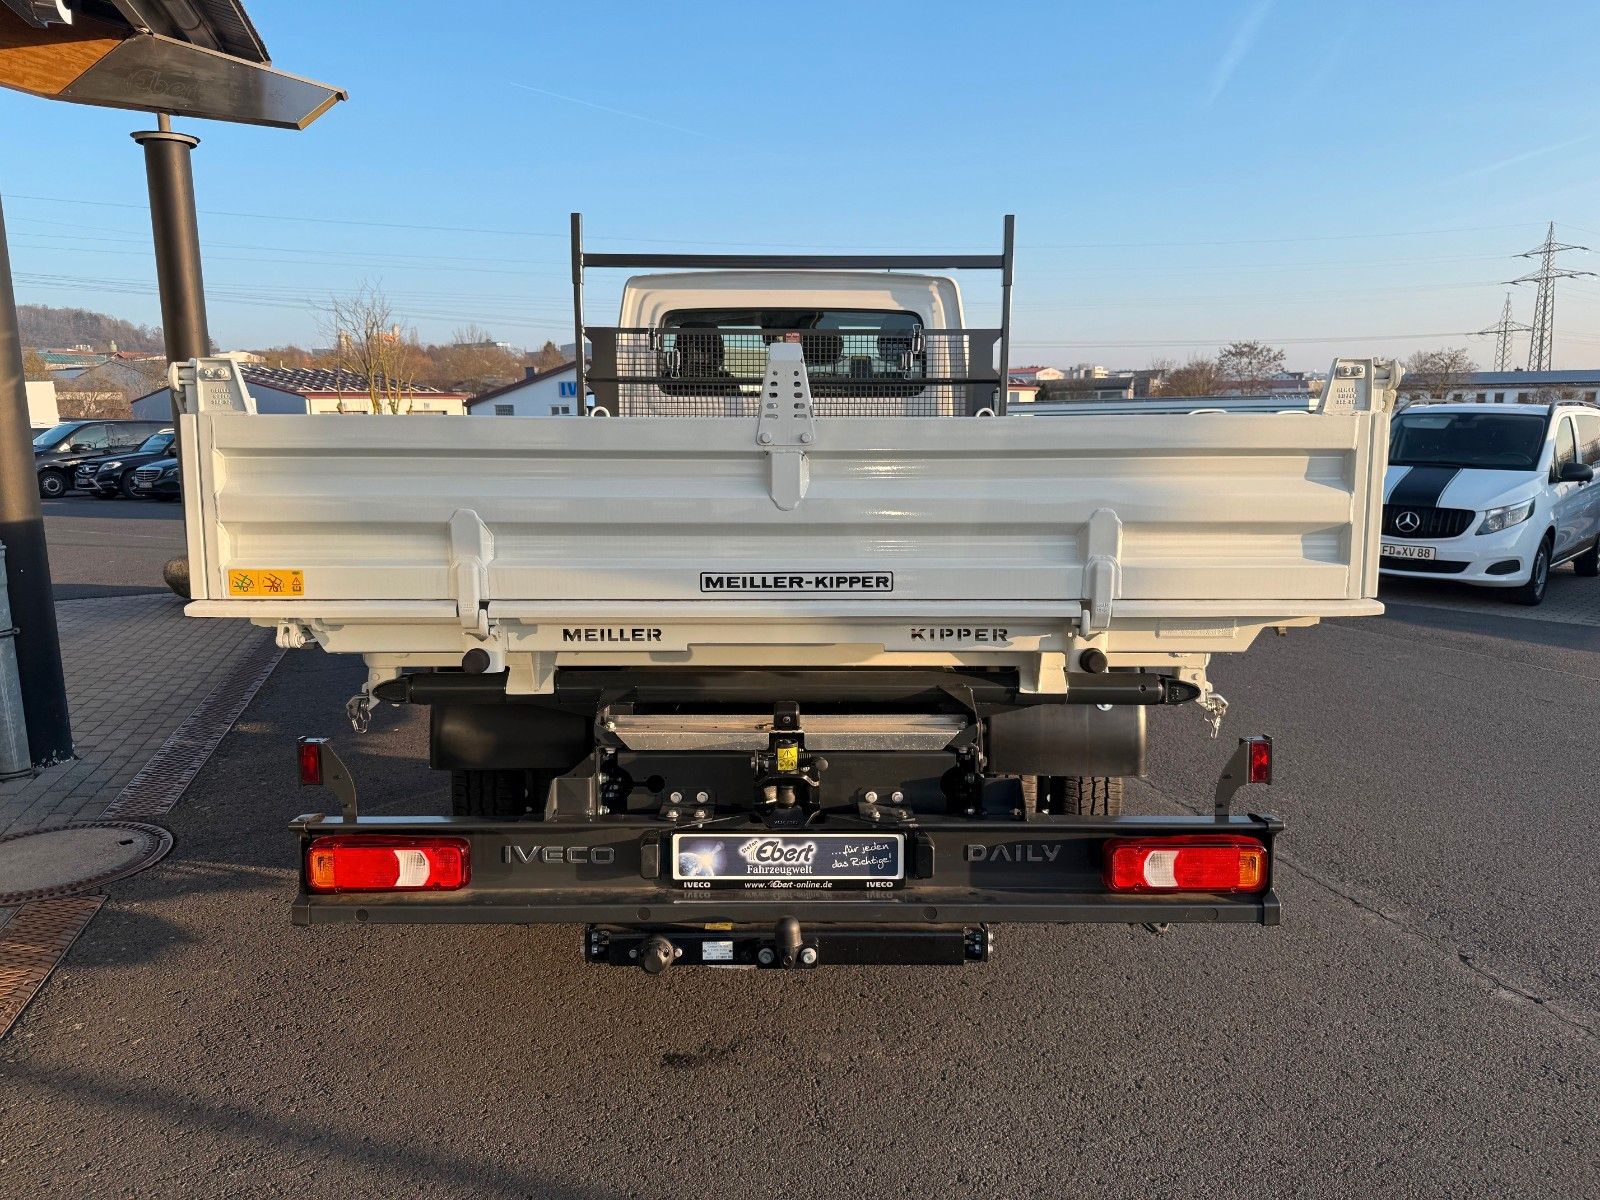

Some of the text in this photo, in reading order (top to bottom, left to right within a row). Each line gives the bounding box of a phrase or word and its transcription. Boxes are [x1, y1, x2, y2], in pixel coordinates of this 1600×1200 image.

[1382, 545, 1430, 558] FD XV 88
[705, 576, 890, 589] MEILLER-KIPPER
[562, 628, 662, 642] MEILLER
[911, 628, 1008, 642] KIPPER
[503, 845, 615, 864] IVECO
[756, 840, 814, 862] Ebert
[861, 842, 889, 853] jeden
[966, 844, 1061, 862] DAILY
[831, 852, 892, 870] das Richtige!
[746, 864, 813, 876] Fahrzeugwelt
